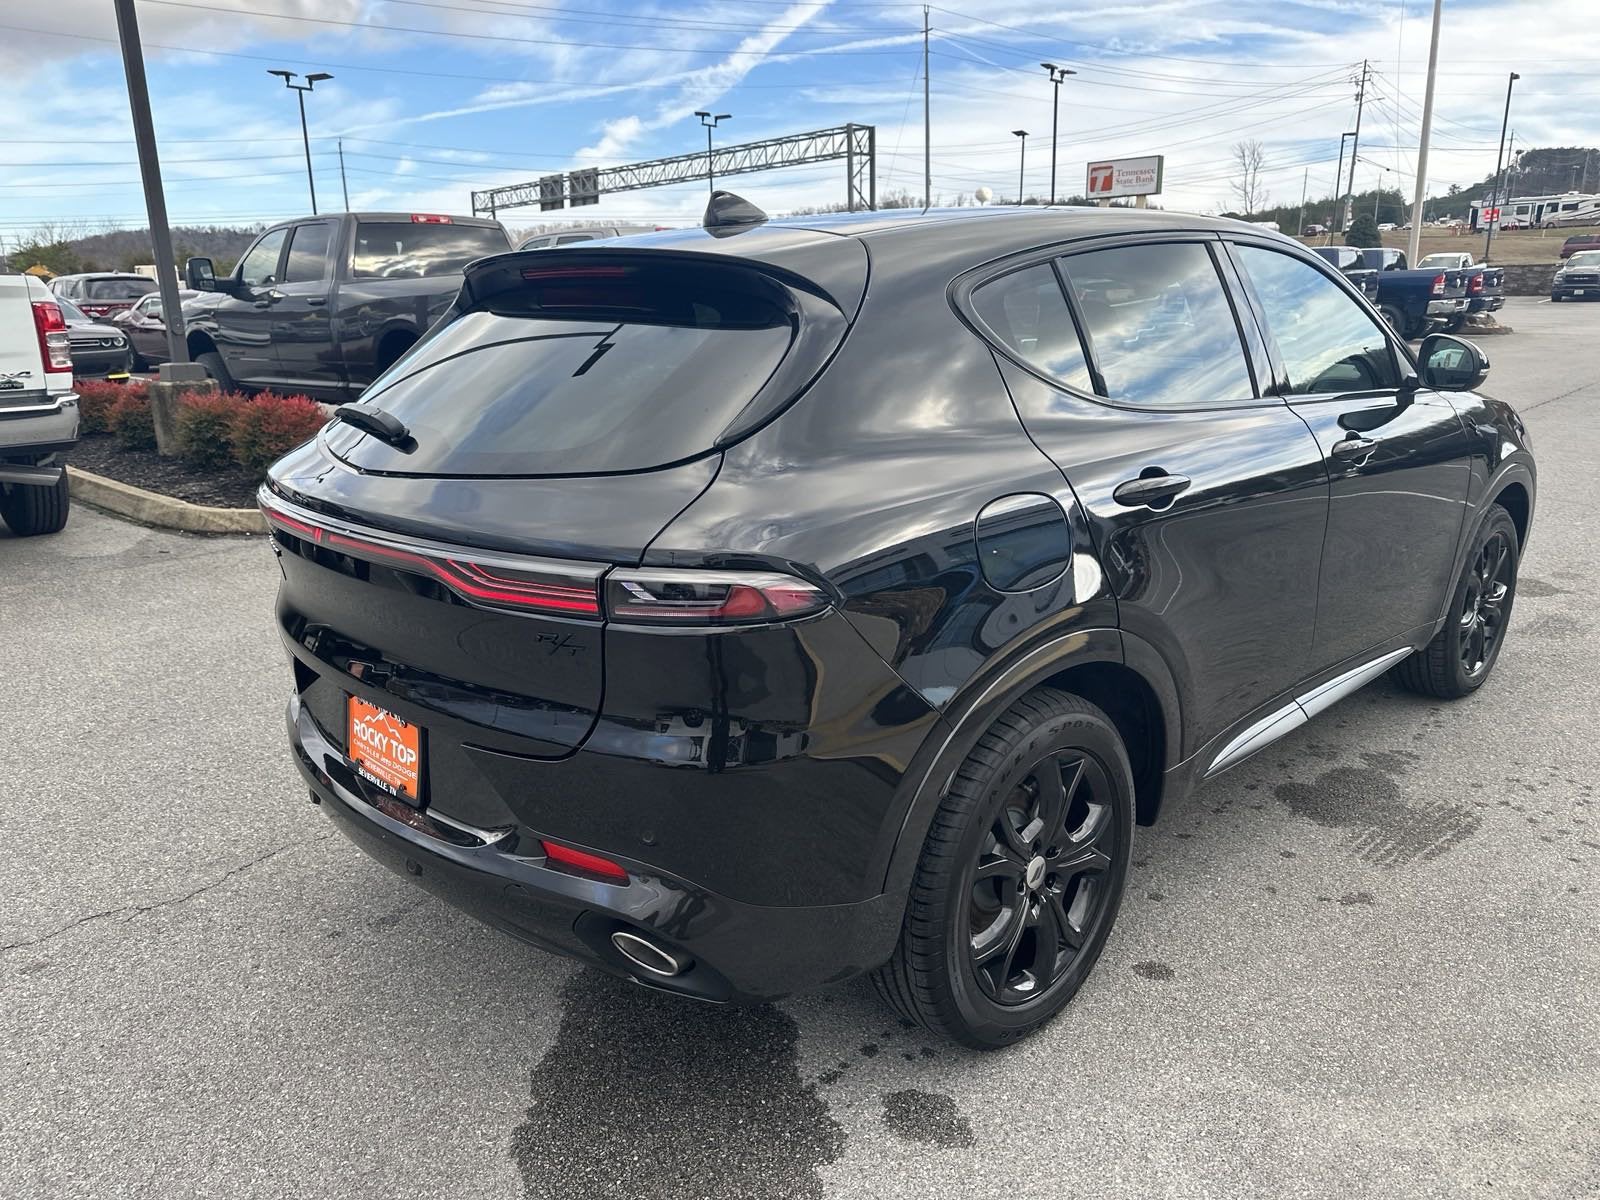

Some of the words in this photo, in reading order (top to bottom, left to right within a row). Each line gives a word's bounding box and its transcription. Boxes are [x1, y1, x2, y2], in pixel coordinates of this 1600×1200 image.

[1116, 168, 1156, 177] Tennessee
[1116, 177, 1134, 185] State
[1135, 175, 1155, 184] Bank
[536, 632, 587, 657] R/T
[353, 719, 389, 753] ROCKY
[390, 739, 417, 766] TOP
[392, 761, 417, 779] DODGE
[389, 786, 397, 797] TN
